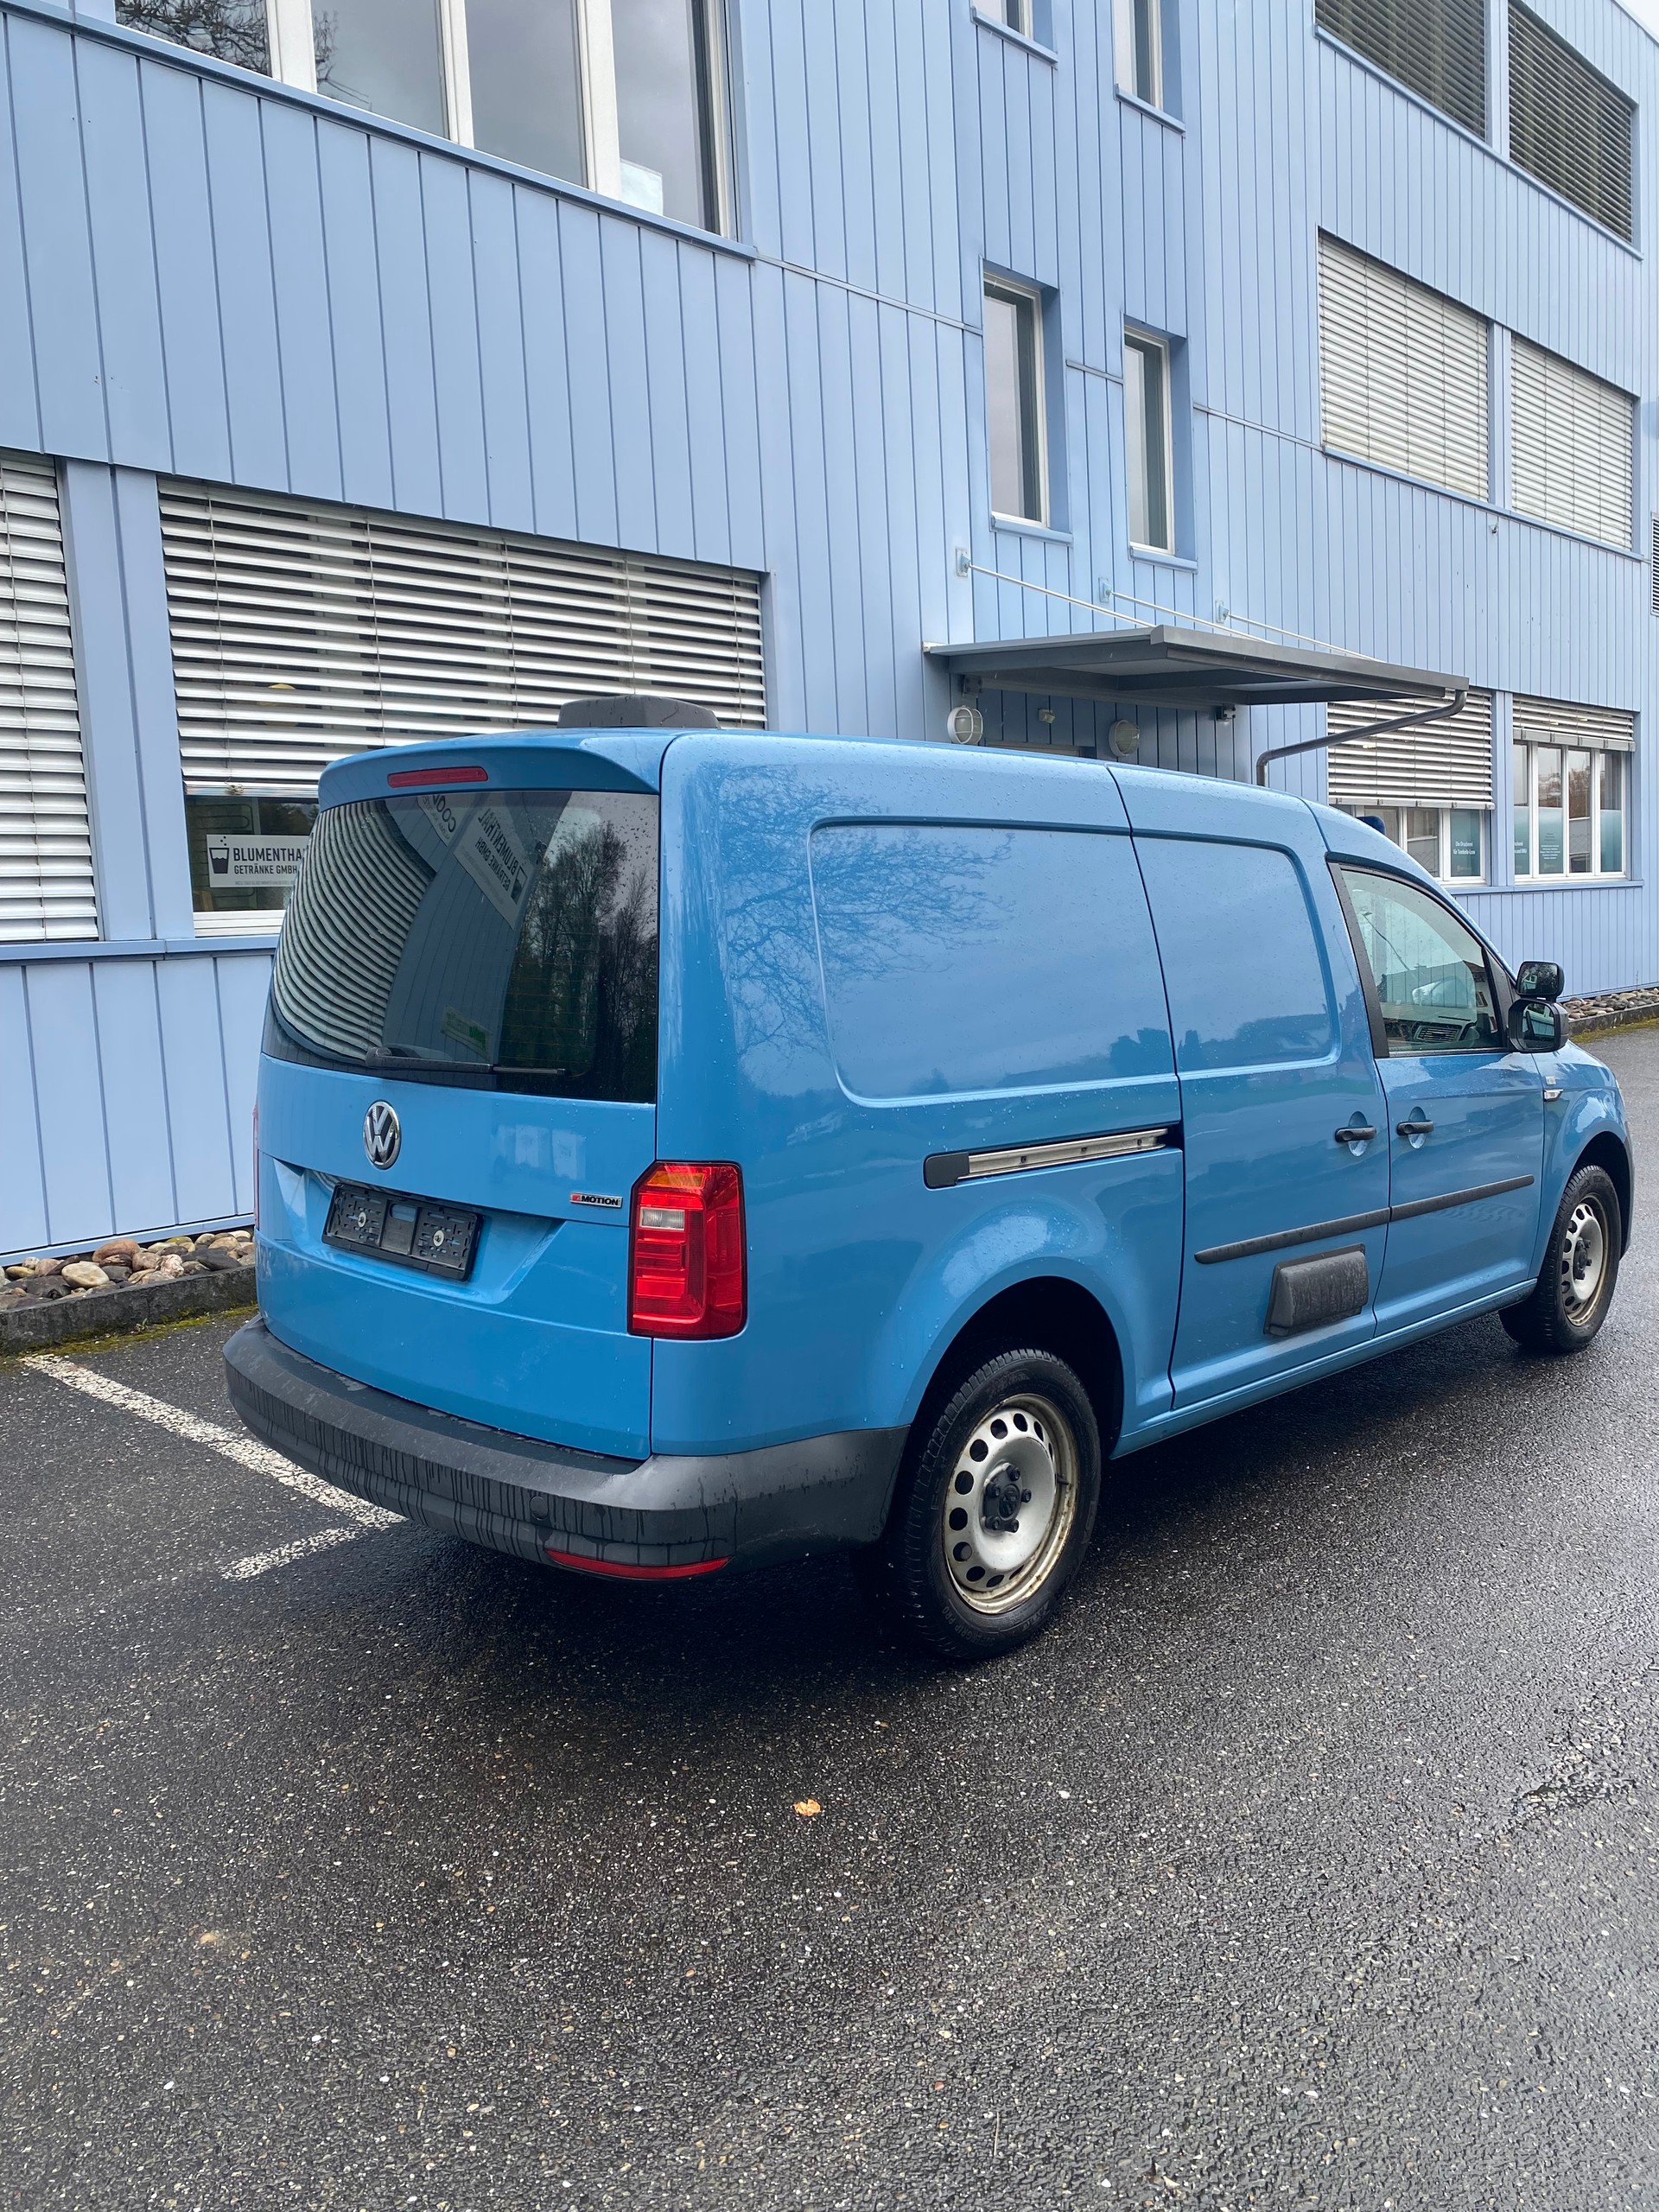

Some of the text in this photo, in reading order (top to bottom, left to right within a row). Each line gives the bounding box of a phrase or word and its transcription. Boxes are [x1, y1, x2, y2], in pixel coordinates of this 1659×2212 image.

[233, 848, 305, 861] BLUMENTHA
[234, 863, 297, 874] GETRÄNKE GMBH
[363, 1101, 401, 1168] VW
